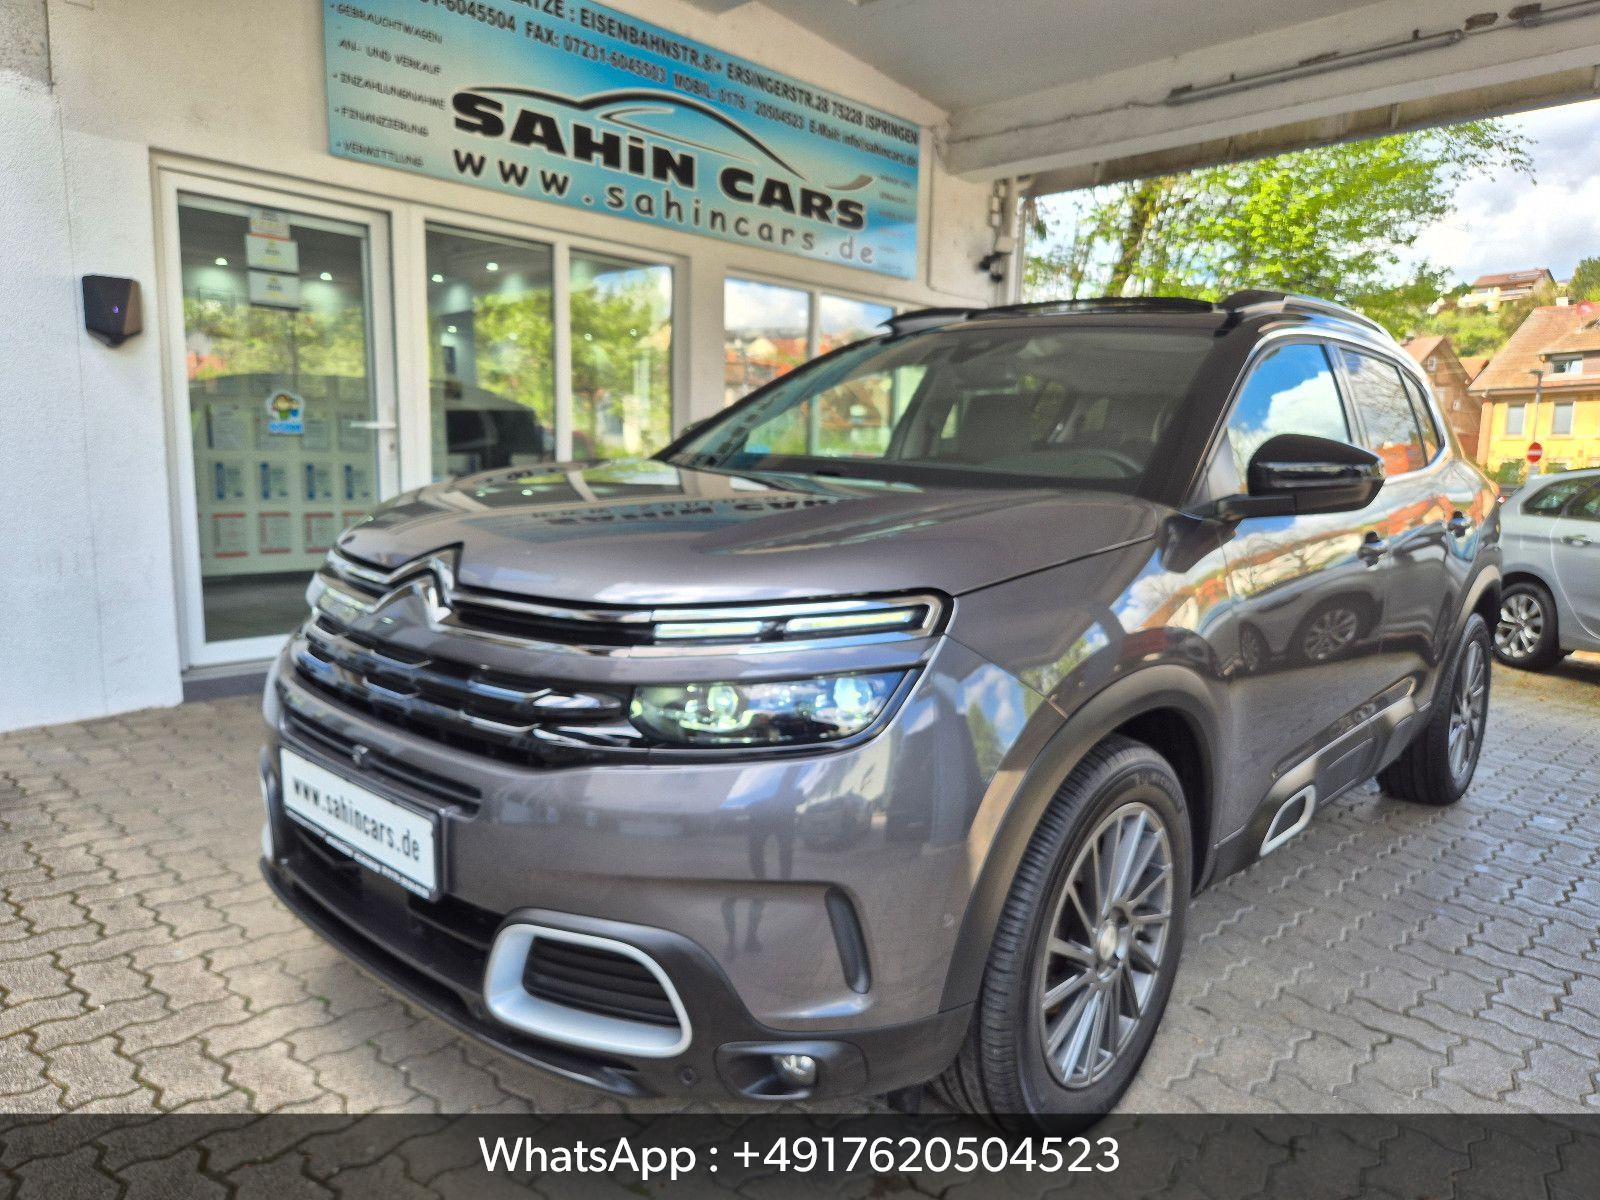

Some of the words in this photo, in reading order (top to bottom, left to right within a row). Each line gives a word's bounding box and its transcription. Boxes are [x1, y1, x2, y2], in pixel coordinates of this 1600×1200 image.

[865, 114, 919, 145] ISPRINGEN
[720, 167, 865, 231] CARS
[293, 777, 420, 862] www.sahincars.de
